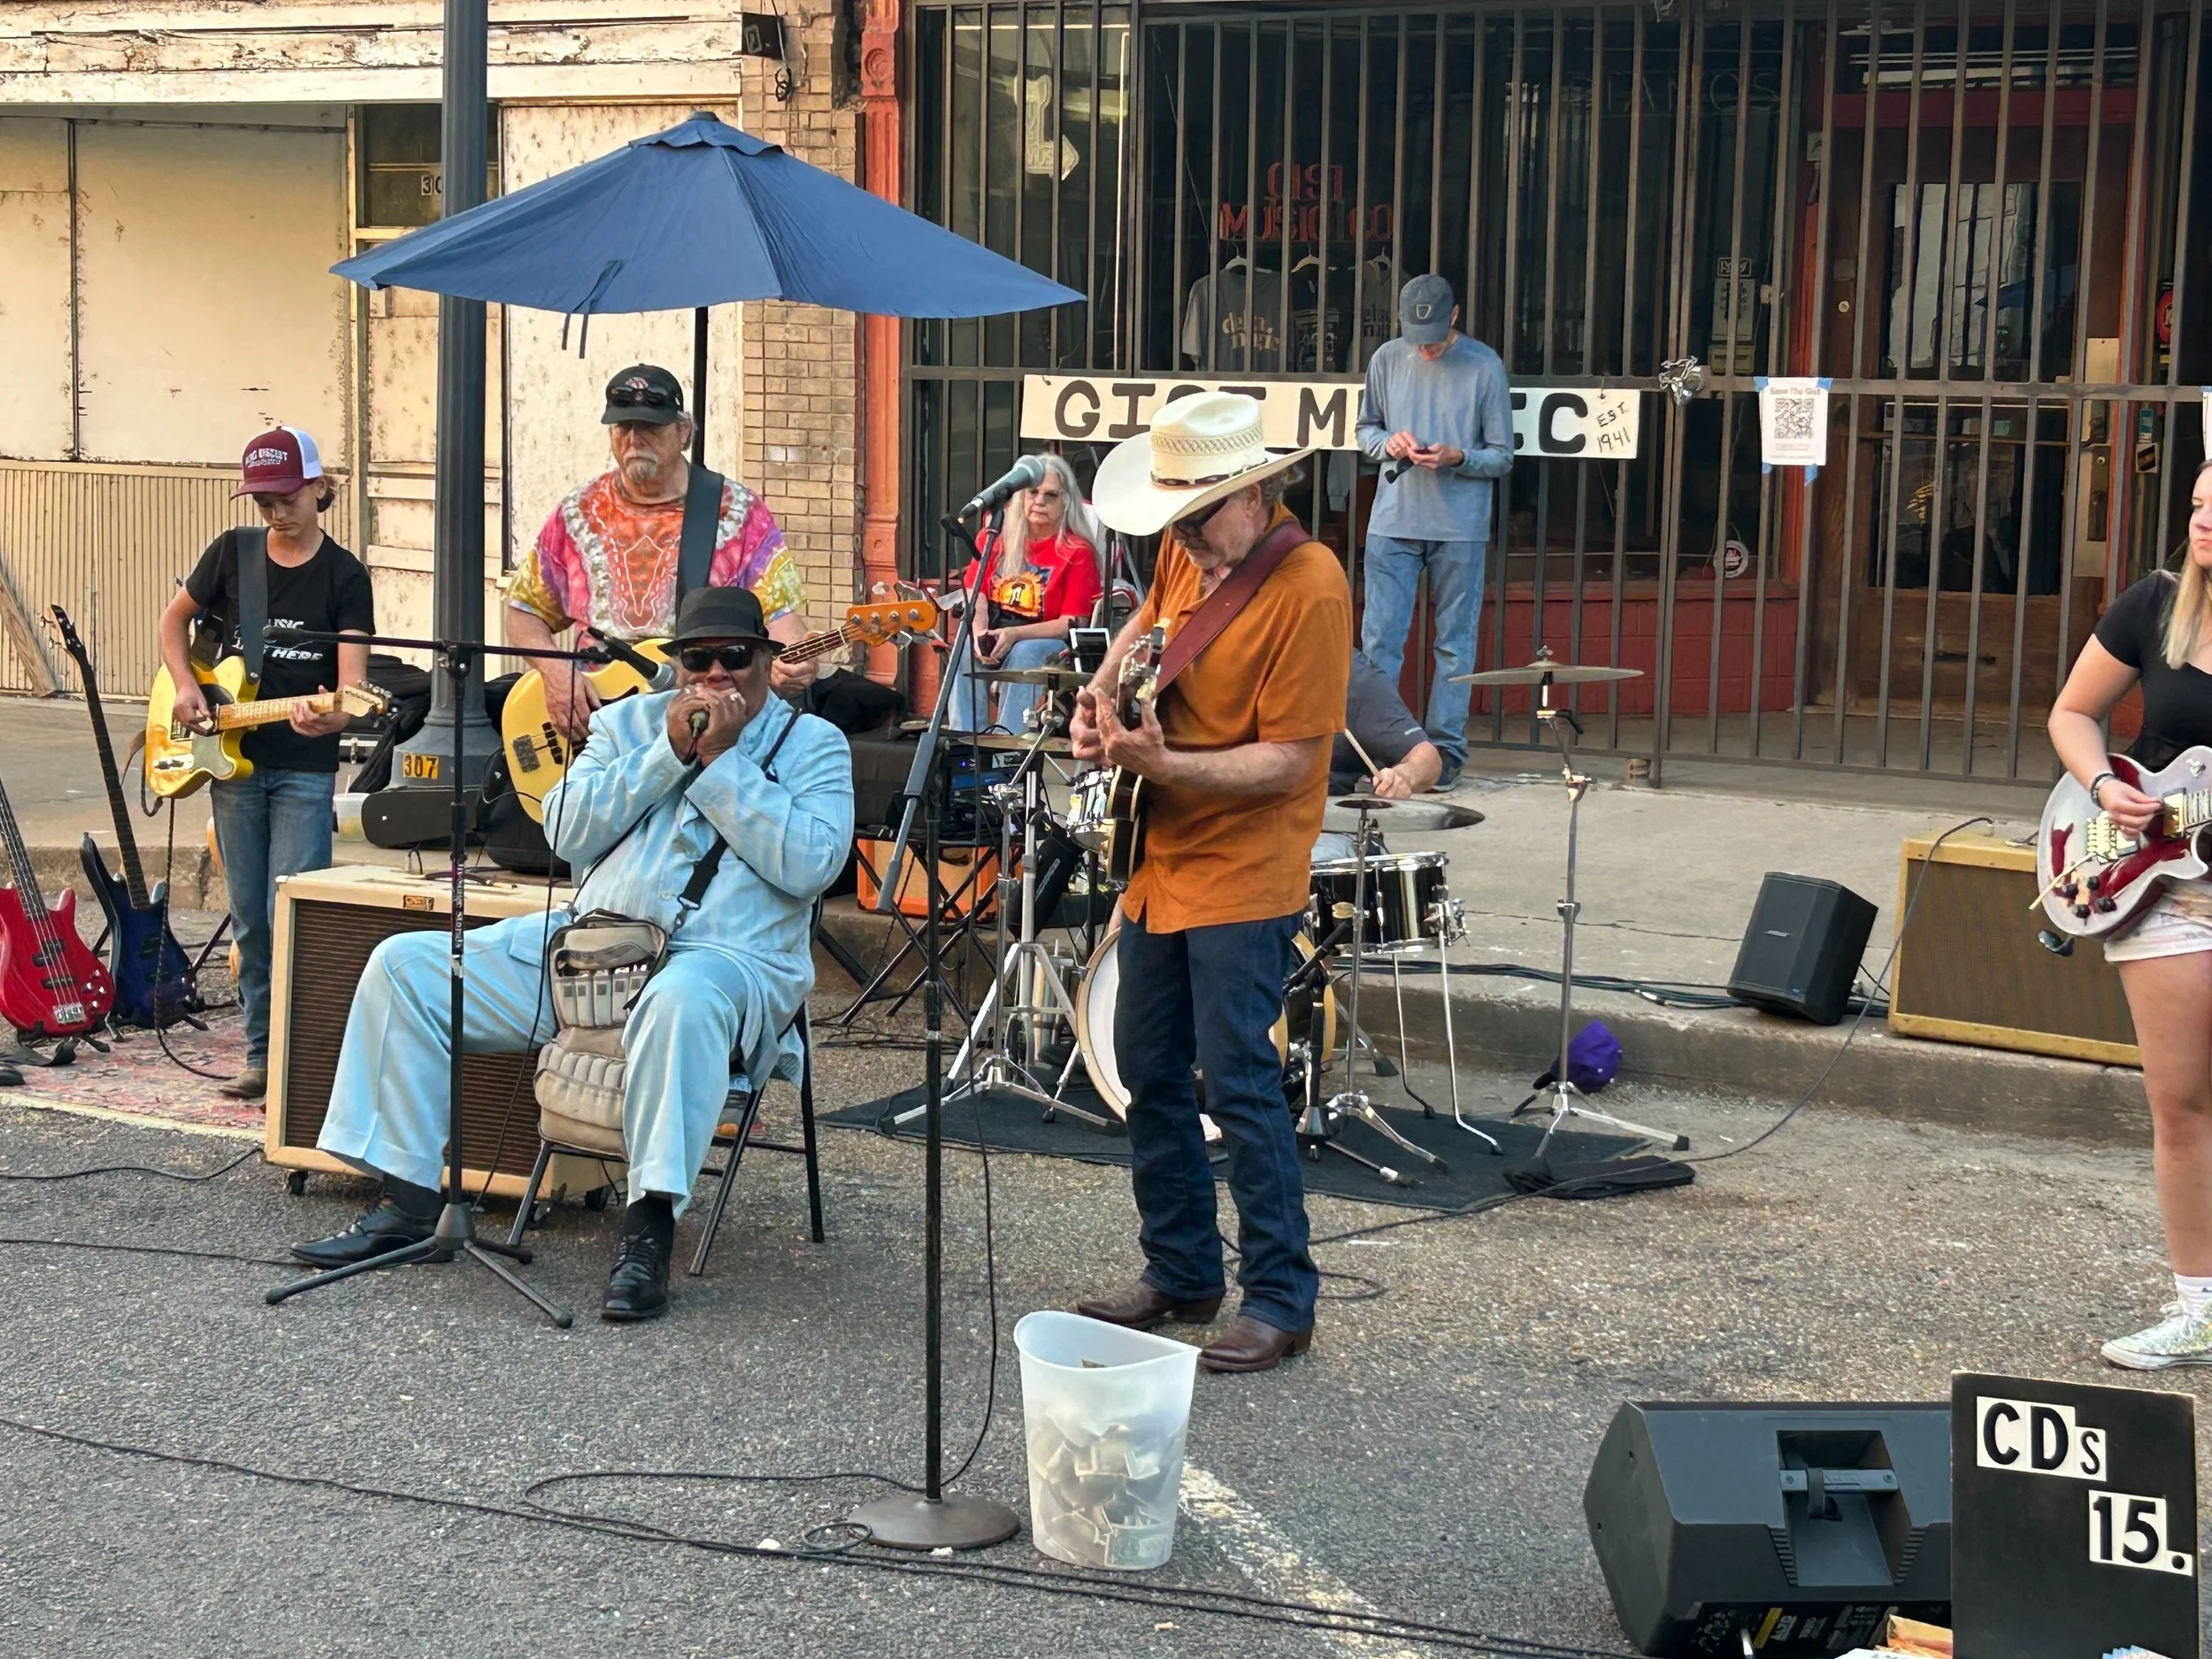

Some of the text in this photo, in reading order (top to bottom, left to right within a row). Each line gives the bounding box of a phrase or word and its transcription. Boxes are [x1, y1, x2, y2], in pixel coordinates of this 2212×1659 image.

[1597, 426, 1631, 454] 1941
[404, 754, 438, 779] 307
[1983, 1402, 2101, 1476] CDs
[2093, 1494, 2185, 1571] 15.
